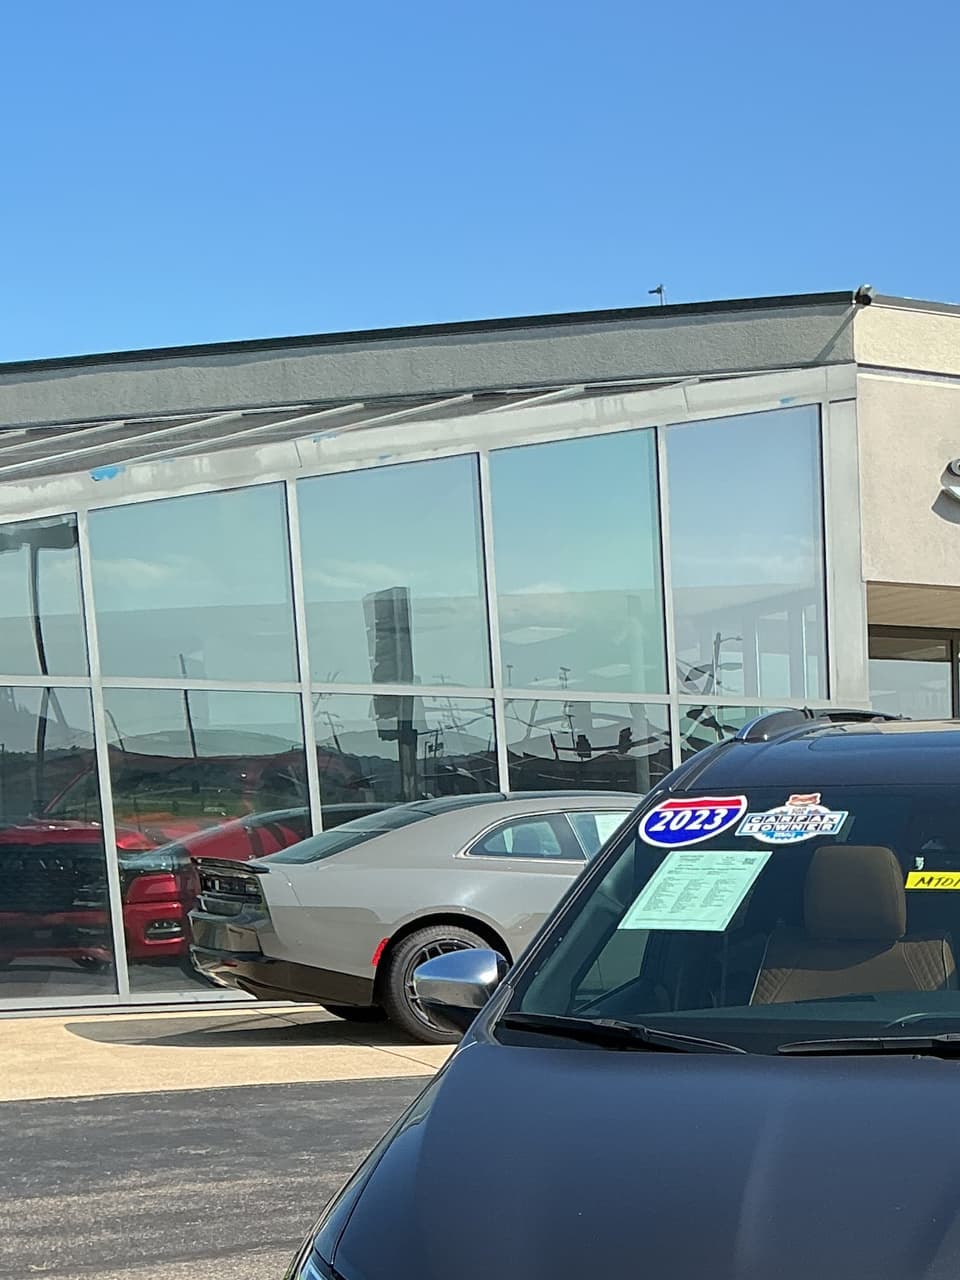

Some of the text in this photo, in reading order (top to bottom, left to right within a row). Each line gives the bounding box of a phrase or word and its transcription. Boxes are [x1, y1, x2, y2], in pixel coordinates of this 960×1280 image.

[649, 808, 729, 832] 2023
[750, 814, 837, 824] CARFAX
[760, 823, 834, 832] OWNER
